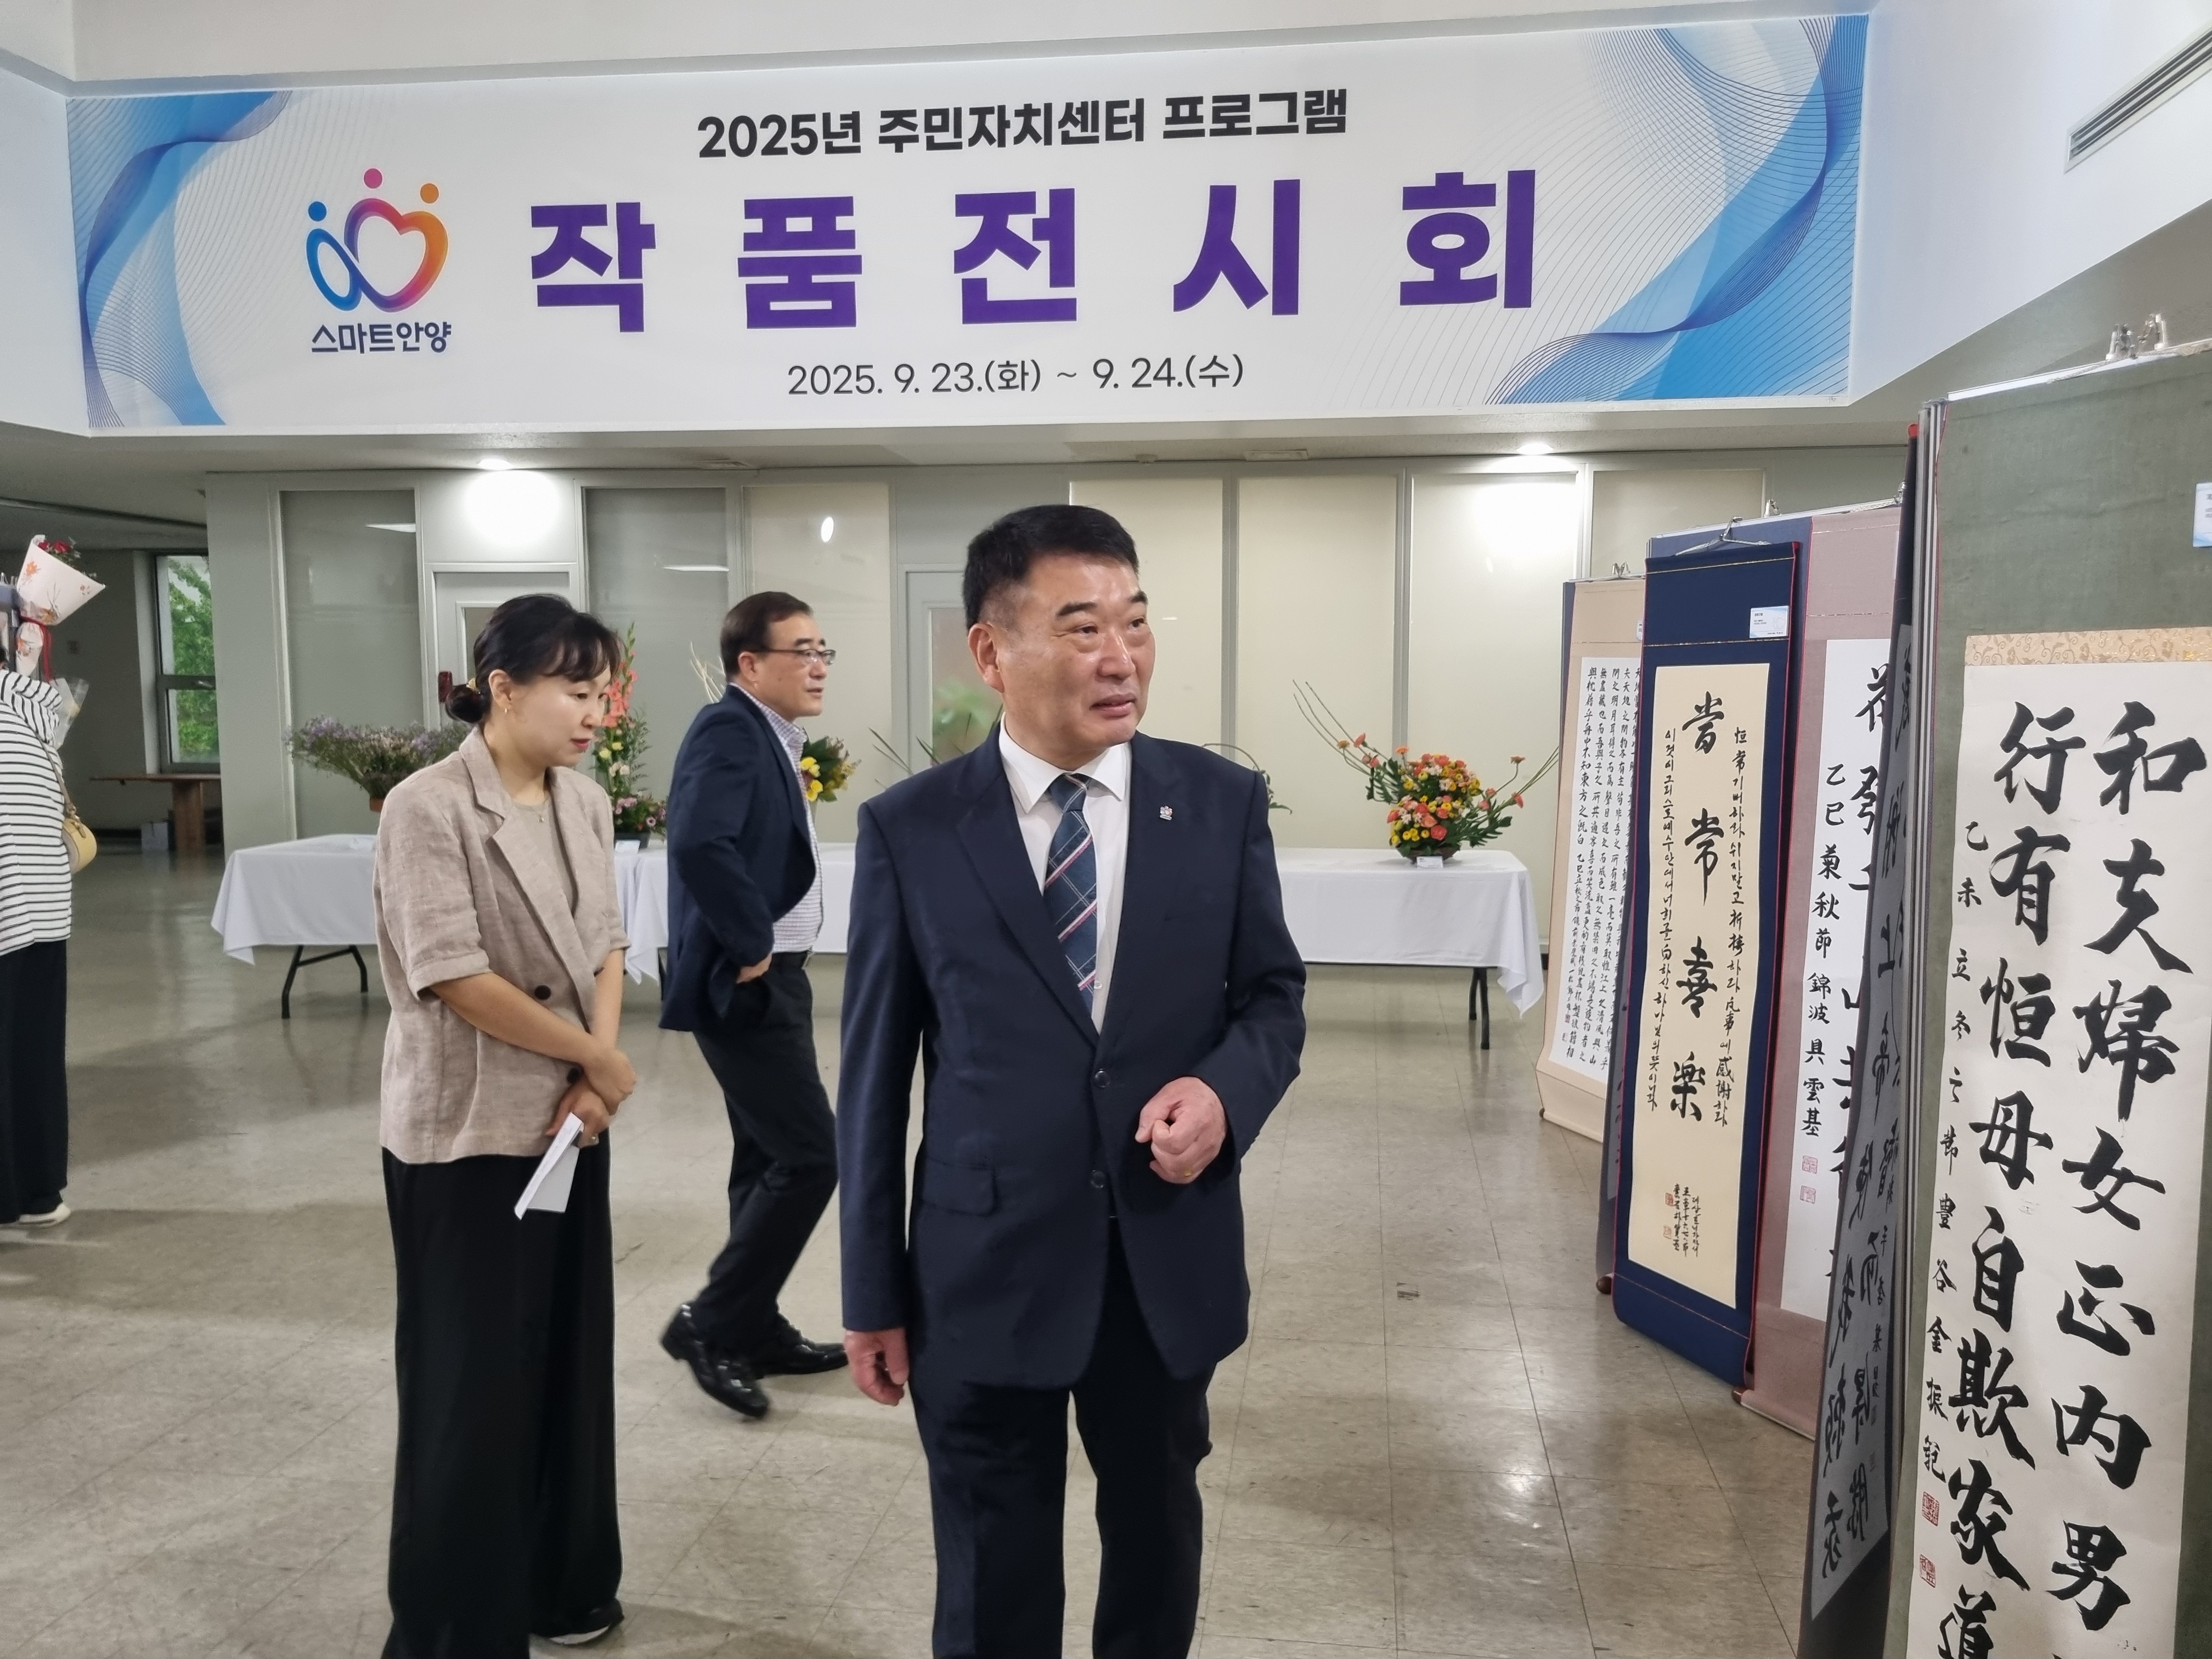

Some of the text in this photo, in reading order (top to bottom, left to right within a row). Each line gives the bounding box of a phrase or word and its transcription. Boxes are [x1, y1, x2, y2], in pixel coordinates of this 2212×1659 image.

[698, 88, 1347, 157] 2025년 주민자치센터 프로그램
[311, 321, 452, 354] 스마트안양
[788, 365, 883, 395] 2025.
[894, 363, 919, 393] 9.
[932, 359, 1041, 393] 23.(화)
[1093, 358, 1119, 389] 9.
[1131, 354, 1243, 388] 24.(수)
